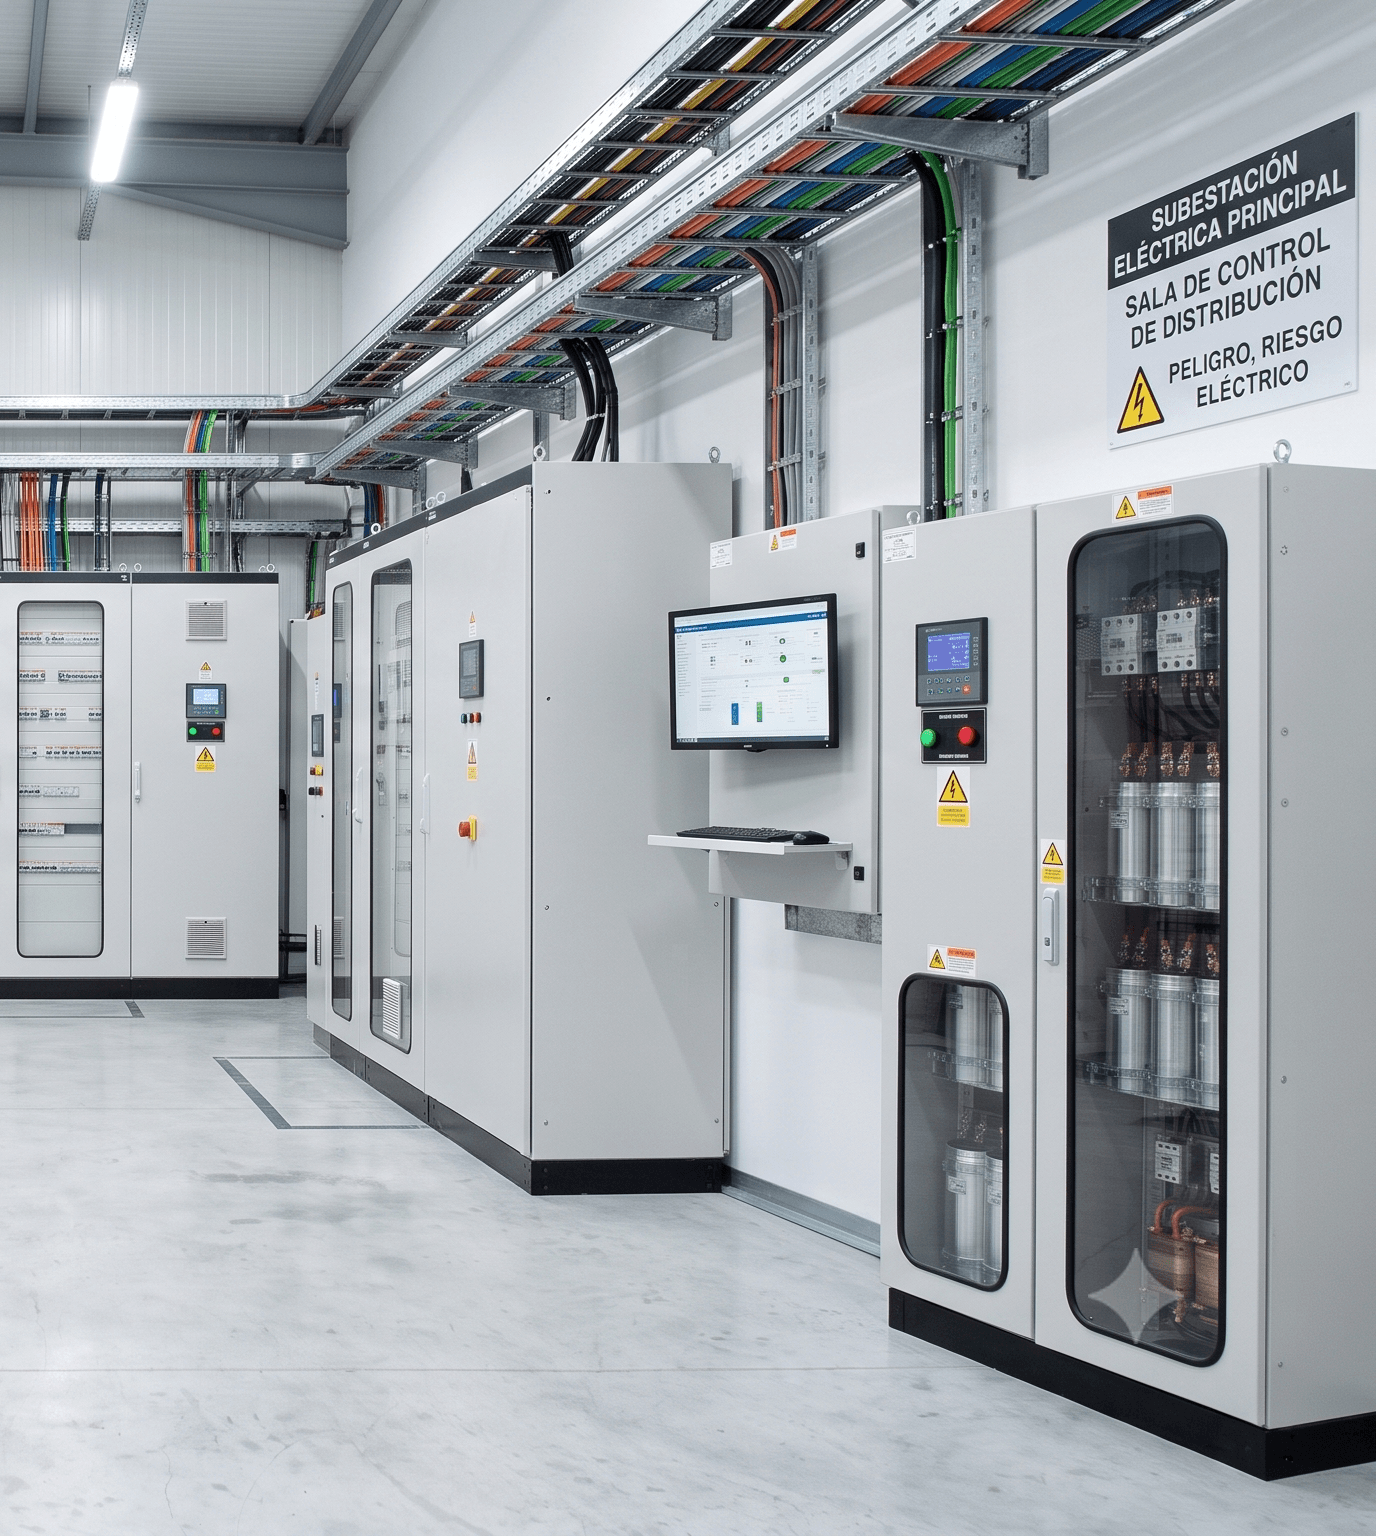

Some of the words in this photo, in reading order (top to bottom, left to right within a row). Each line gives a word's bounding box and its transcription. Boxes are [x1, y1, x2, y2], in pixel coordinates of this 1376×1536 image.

[1113, 218, 1222, 279] ELÉCTRICA
[1227, 168, 1347, 239] PRINCIPAL
[1151, 150, 1298, 232] SUBESTACIÓN
[1125, 281, 1178, 319] SALA
[1183, 267, 1211, 299] DE
[1218, 227, 1331, 286] CONTROL
[1131, 320, 1157, 349] DE
[1163, 265, 1322, 339] DISTRIBUCIÓN
[1169, 342, 1256, 384] PELIGRO,
[1262, 315, 1343, 359] RIESGO
[1196, 359, 1309, 408] ELÉCTRICO
